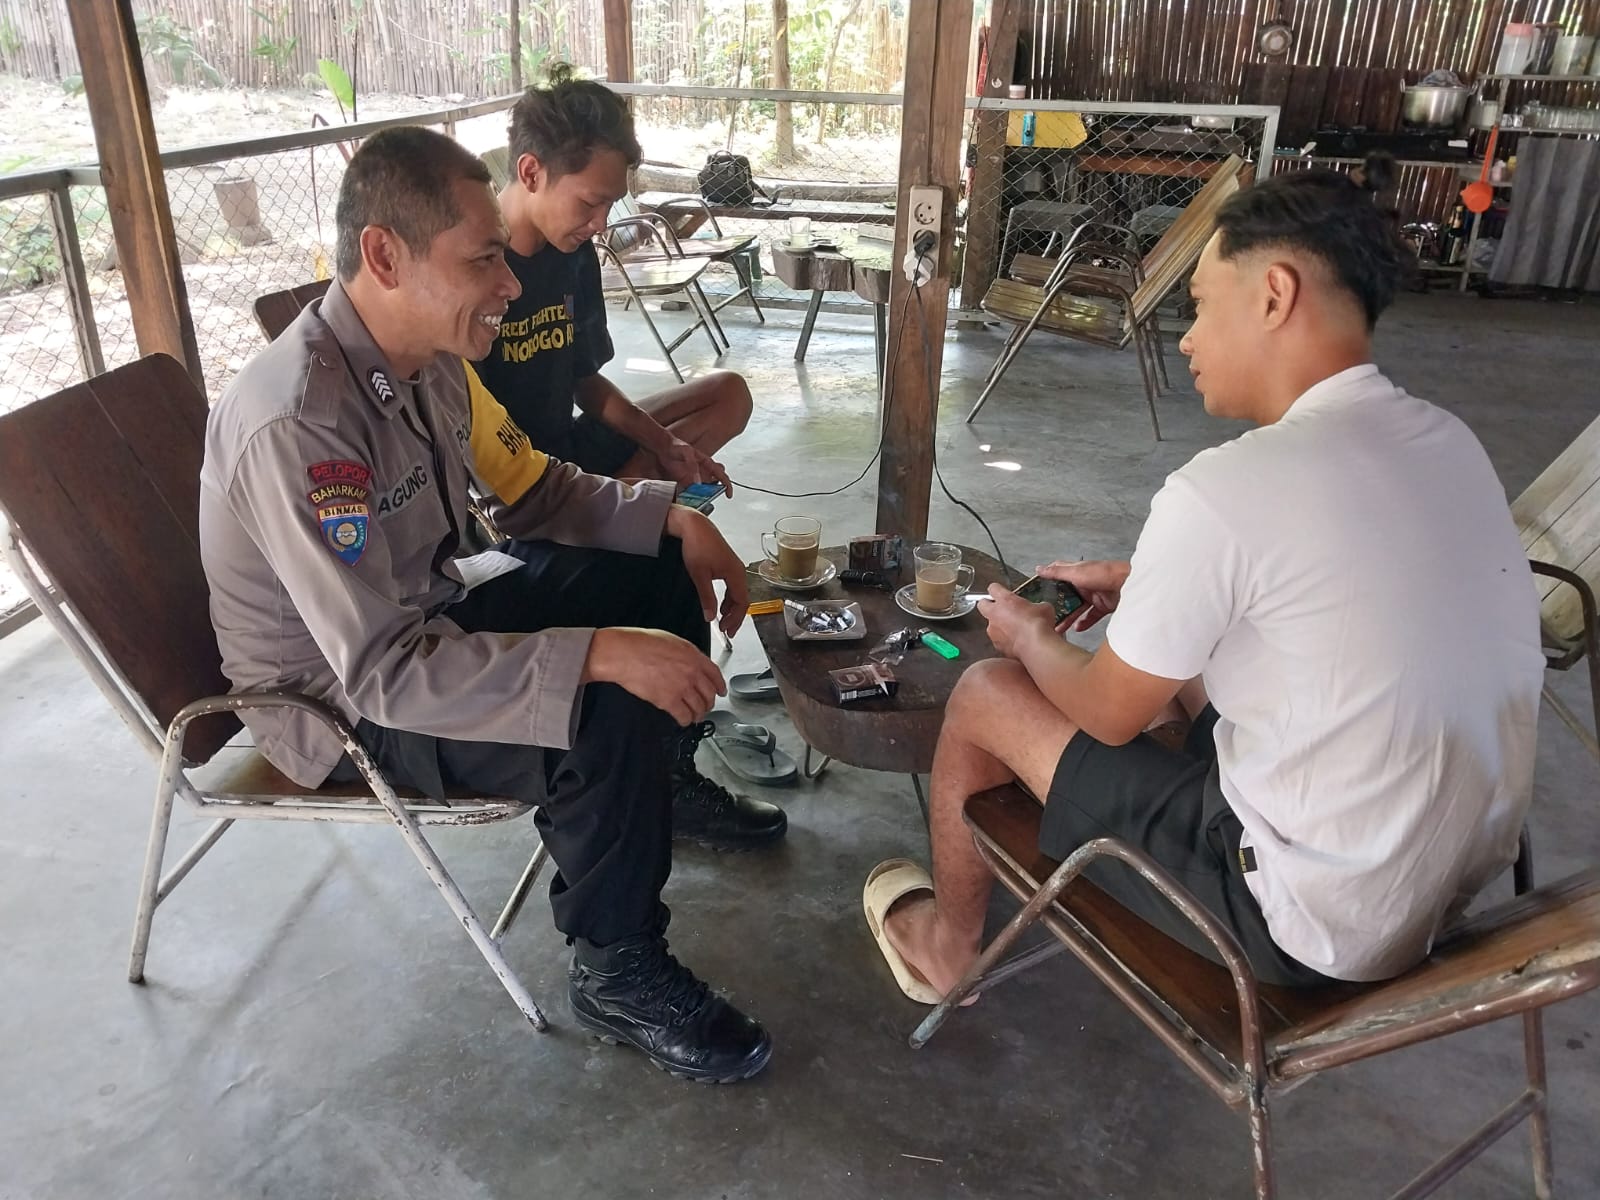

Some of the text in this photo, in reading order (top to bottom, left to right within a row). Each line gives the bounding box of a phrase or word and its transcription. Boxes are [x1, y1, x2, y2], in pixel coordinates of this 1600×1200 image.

[531, 304, 569, 330] FIGHTE
[312, 464, 368, 483] PELOPOR
[310, 484, 367, 504] BAHARKAM
[378, 465, 427, 516] AGUNG
[324, 505, 363, 517] BINMAS
